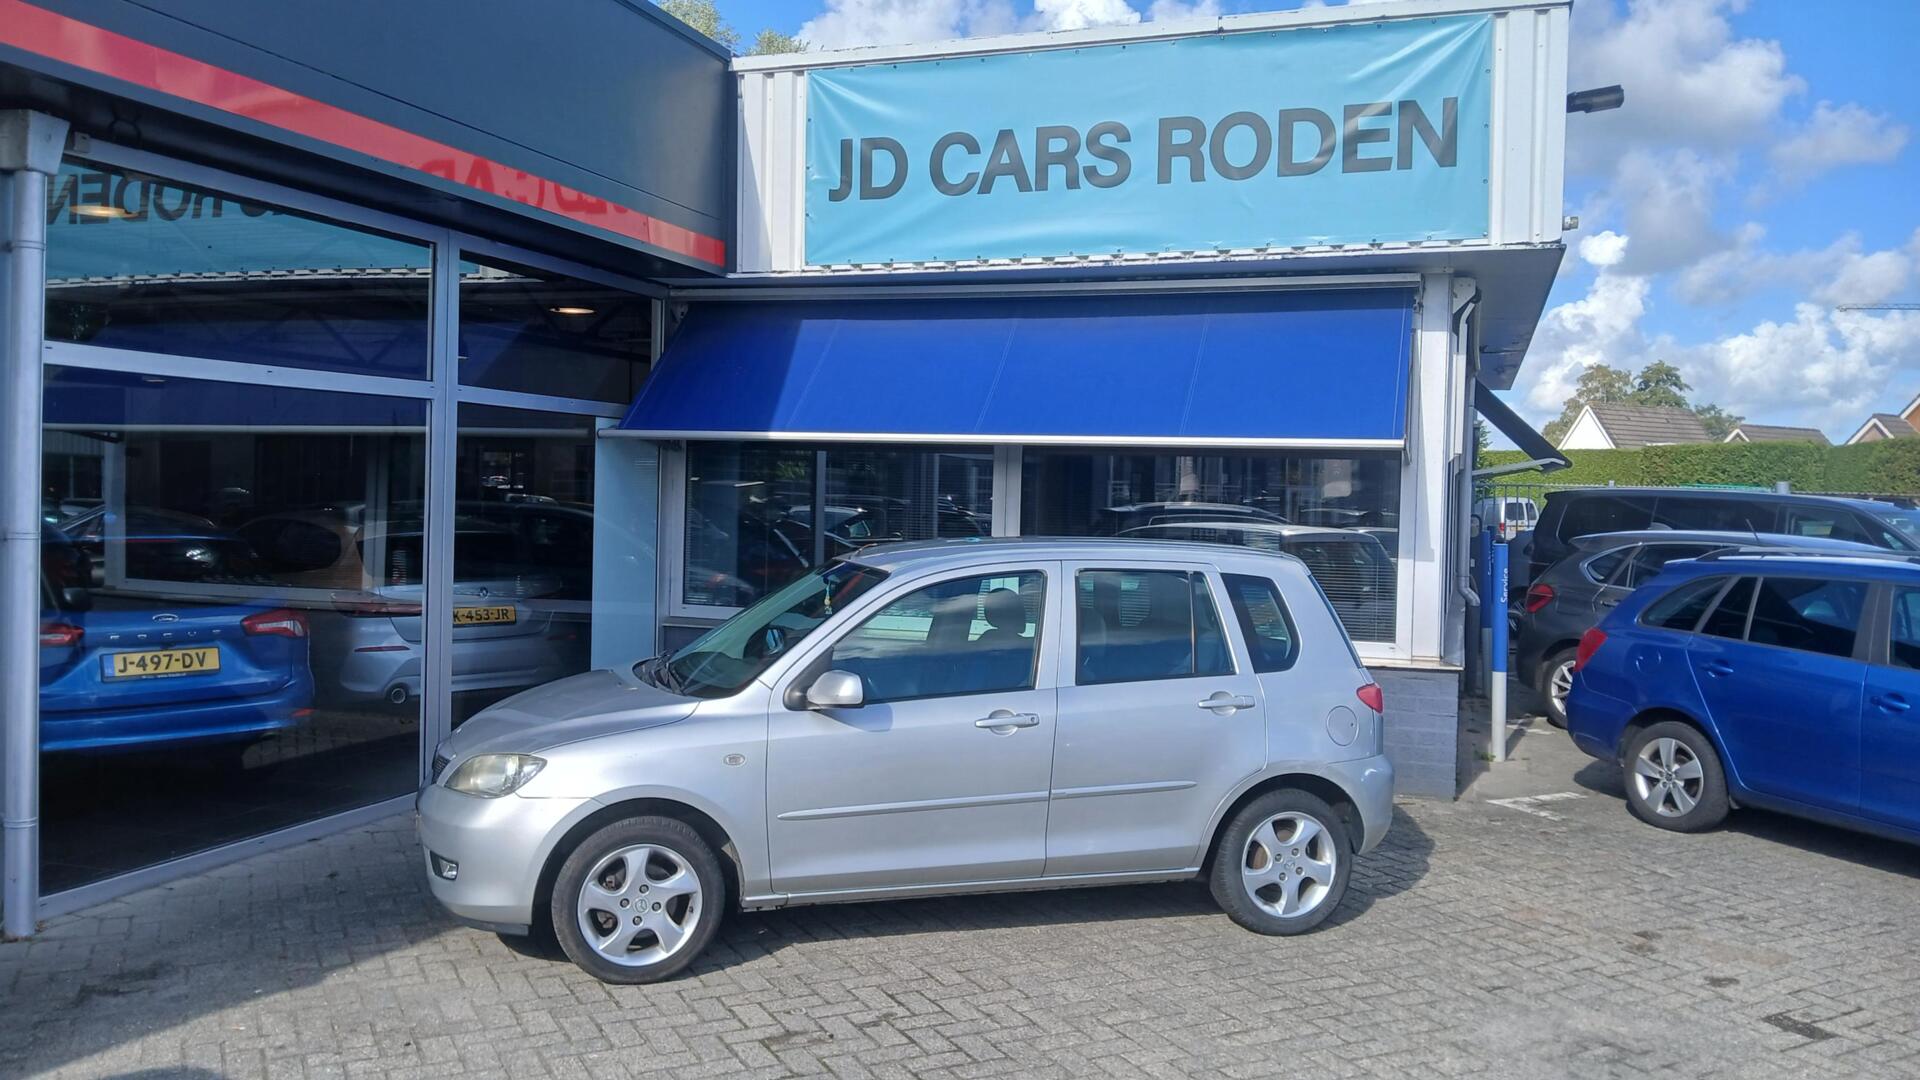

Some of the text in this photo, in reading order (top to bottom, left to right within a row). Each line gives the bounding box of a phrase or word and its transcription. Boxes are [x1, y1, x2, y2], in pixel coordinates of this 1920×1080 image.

[828, 96, 1458, 202] JD CARS RODEN
[1500, 567, 1509, 603] Service
[118, 651, 207, 673] J-497-DV
